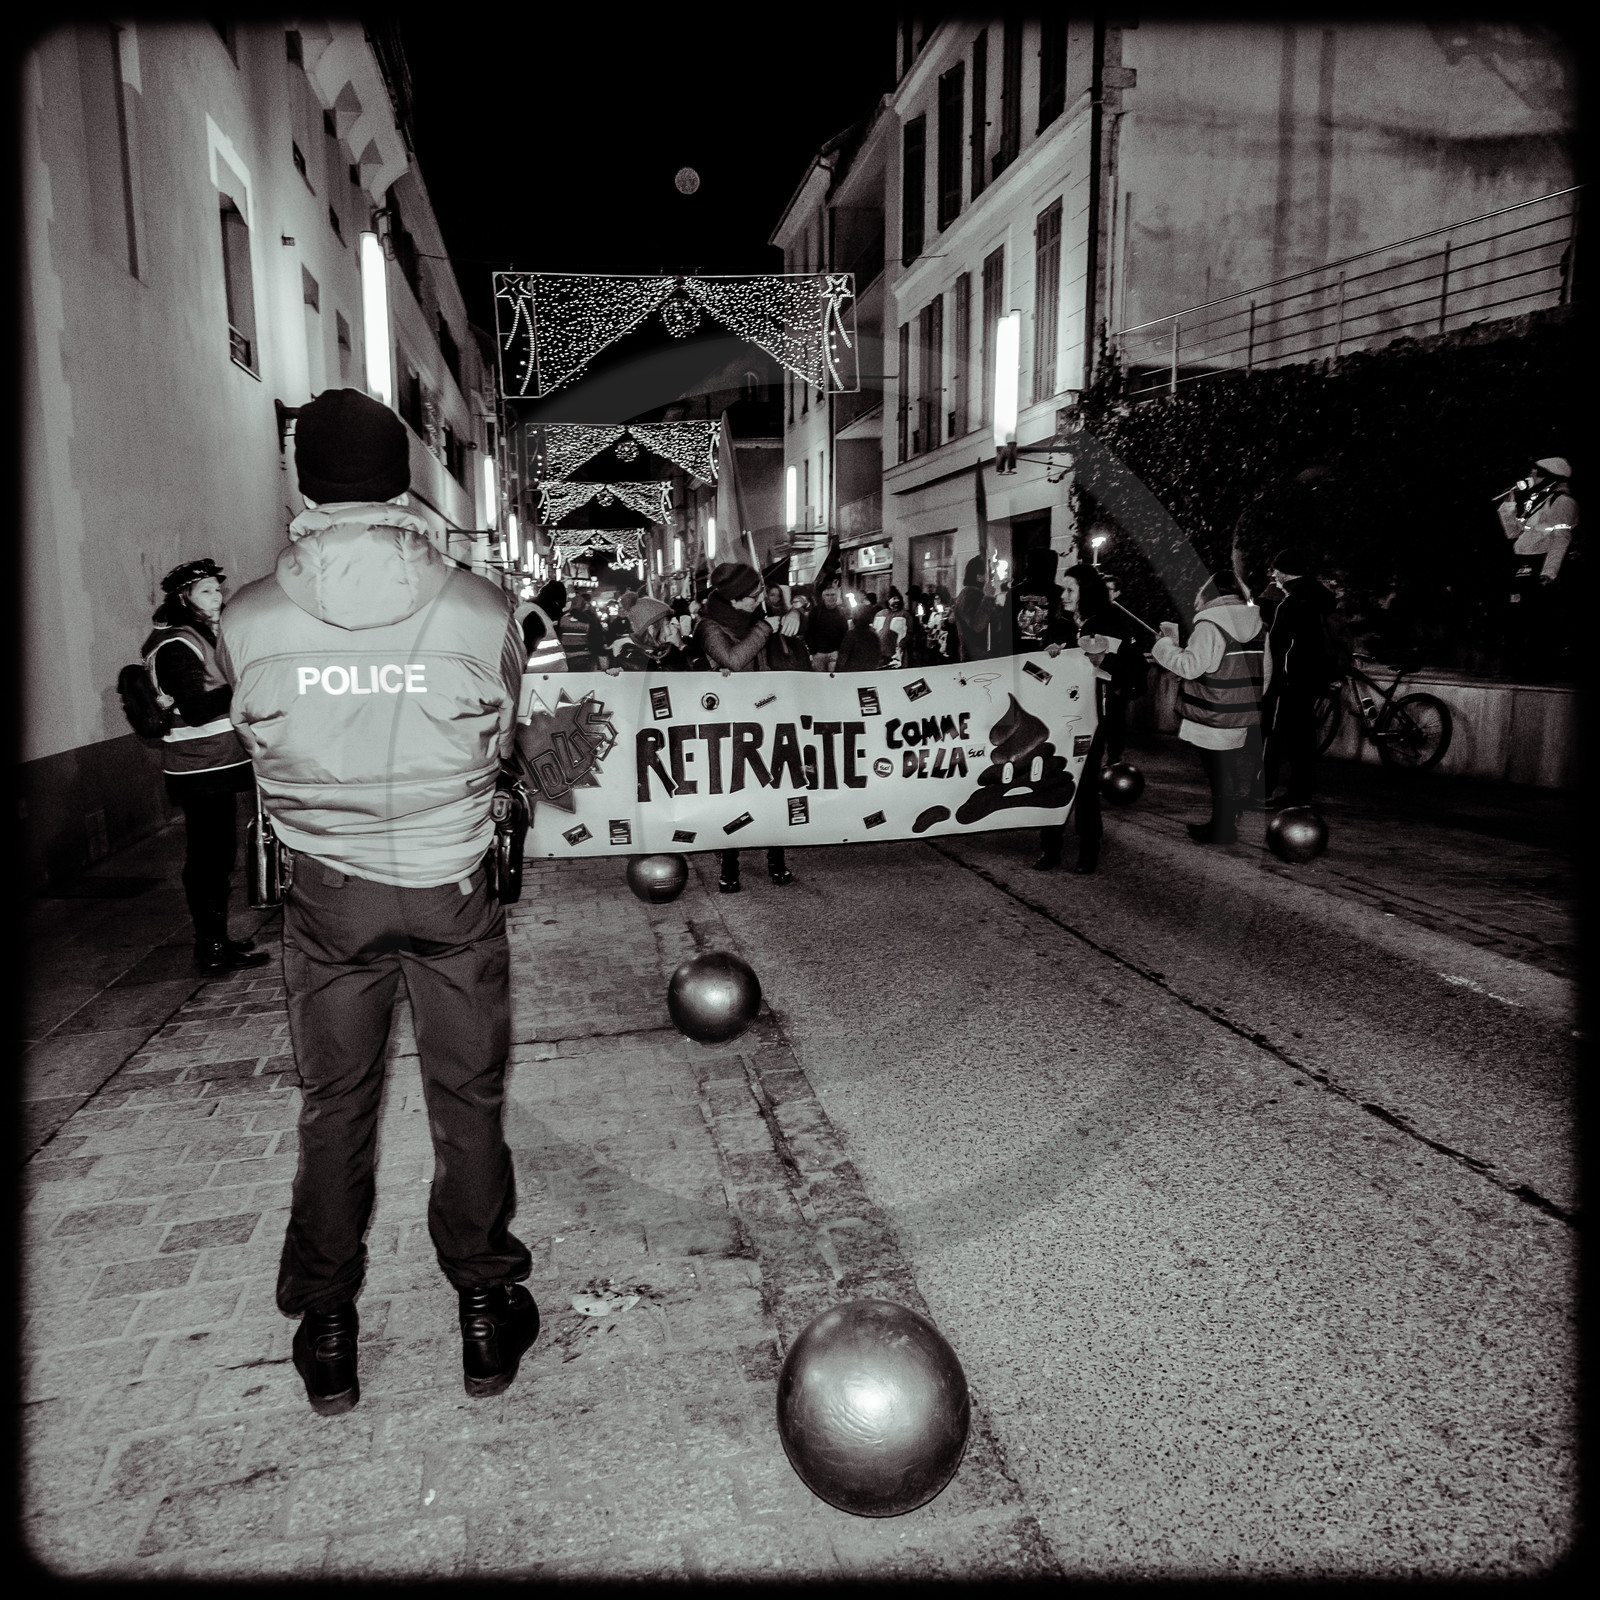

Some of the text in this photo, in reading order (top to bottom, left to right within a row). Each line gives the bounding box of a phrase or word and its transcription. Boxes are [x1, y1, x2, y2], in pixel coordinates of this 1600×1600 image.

[297, 664, 427, 695] POLICE
[514, 698, 619, 800] OUS
[885, 712, 971, 750] COMME
